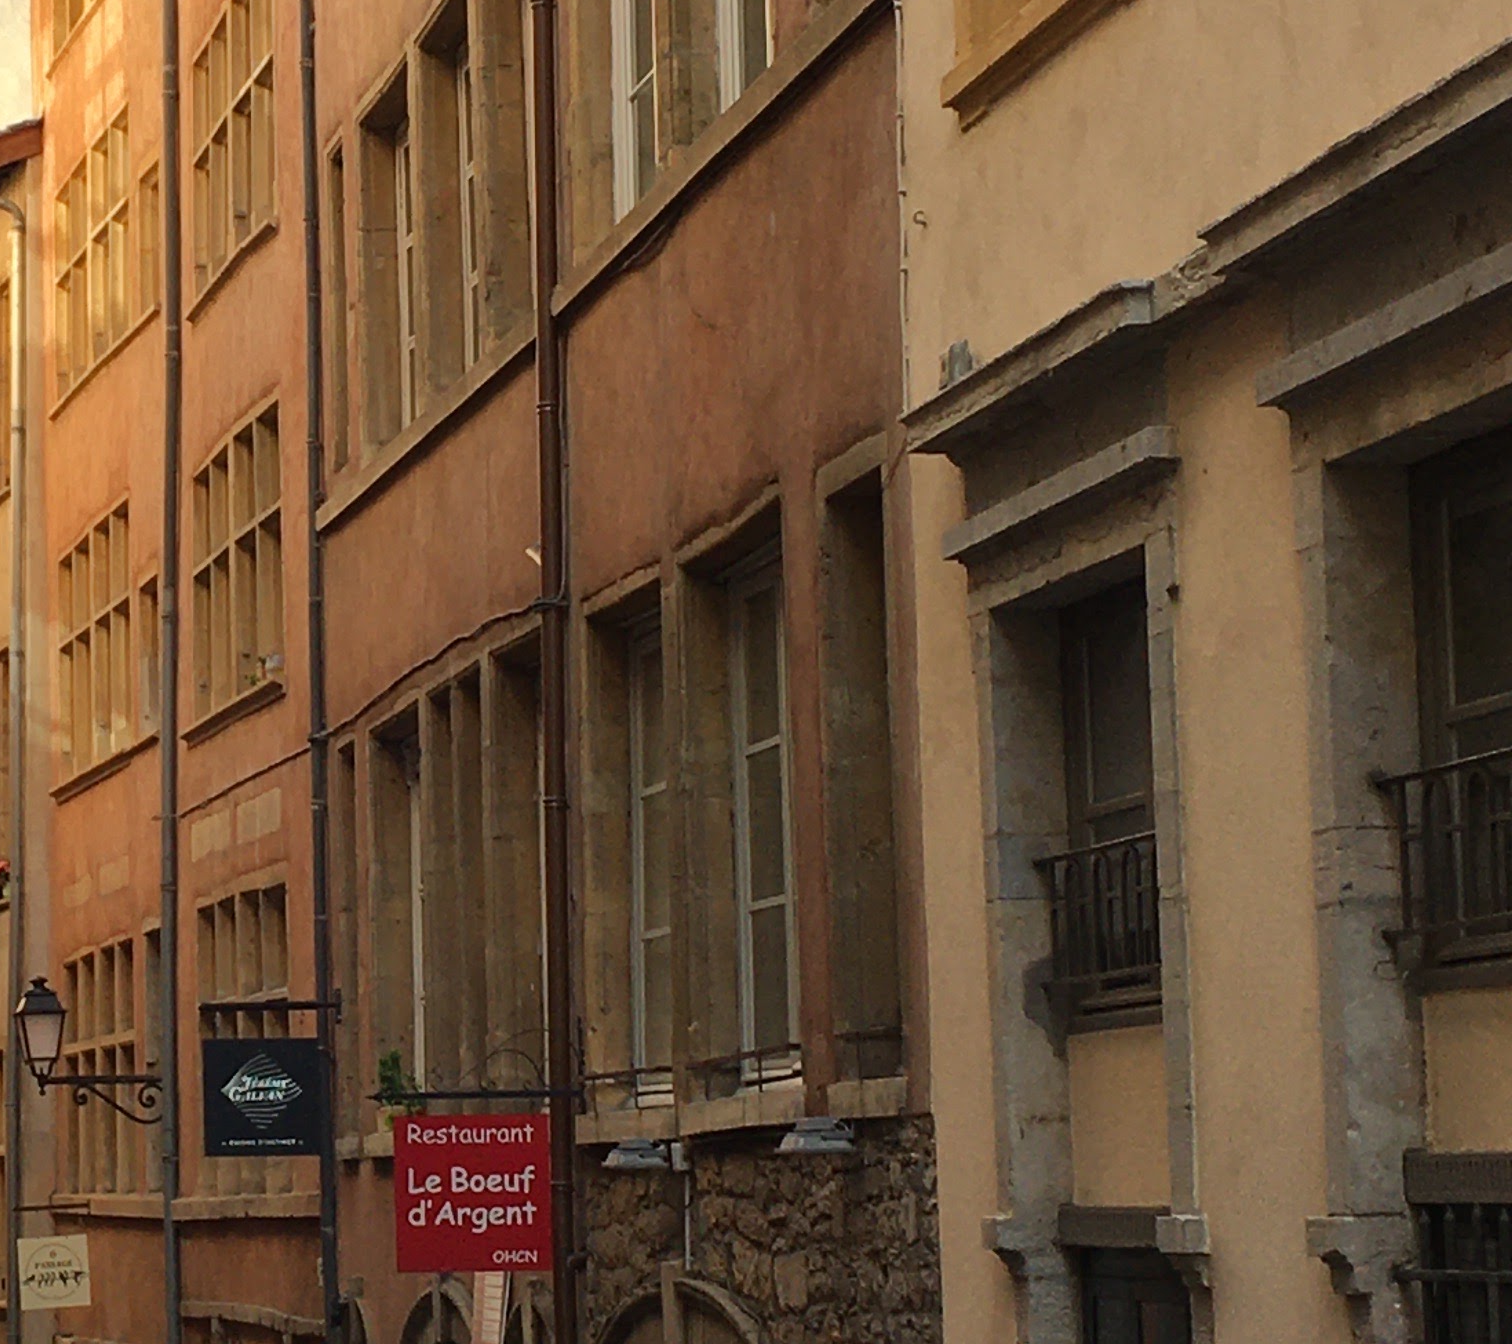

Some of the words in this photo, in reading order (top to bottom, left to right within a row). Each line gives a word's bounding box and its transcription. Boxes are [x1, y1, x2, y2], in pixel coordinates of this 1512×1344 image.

[406, 1122, 534, 1145] Restaurant
[407, 1167, 443, 1194] Le
[450, 1164, 536, 1194] Boeuf
[407, 1198, 538, 1234] d'Argent
